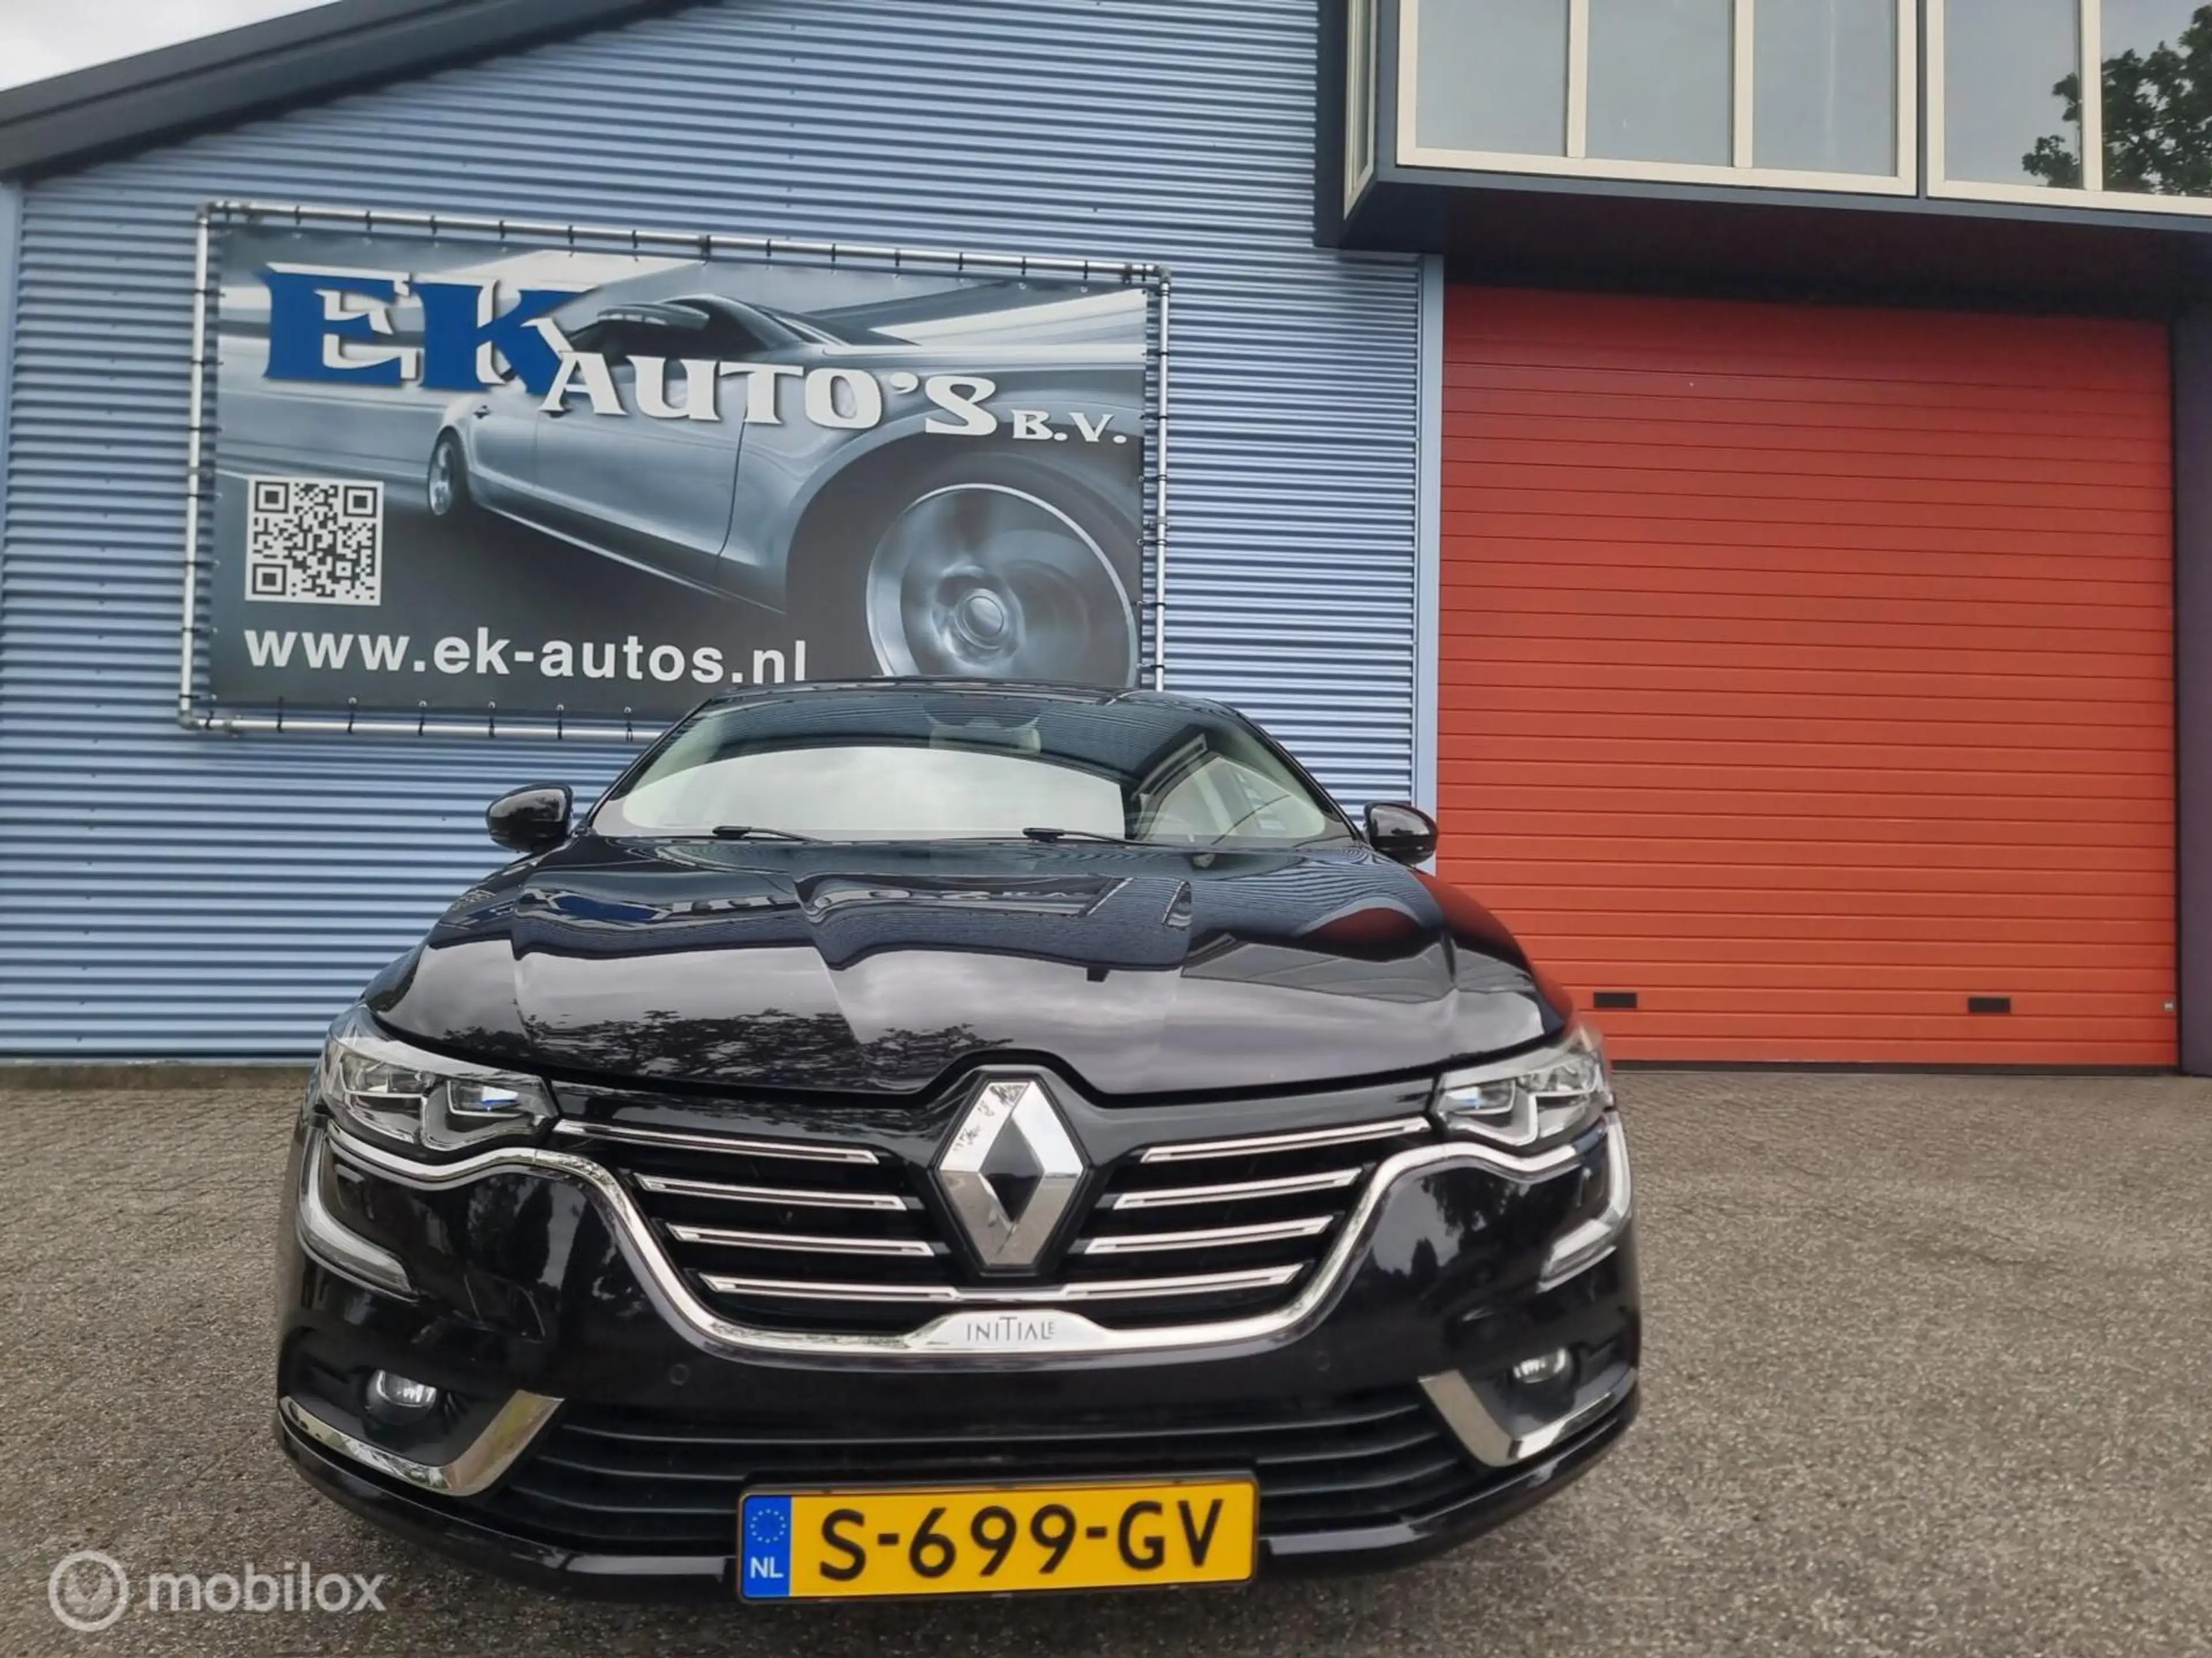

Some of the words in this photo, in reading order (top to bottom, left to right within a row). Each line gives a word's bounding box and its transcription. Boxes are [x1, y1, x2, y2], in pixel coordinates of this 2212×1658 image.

[263, 262, 602, 399] EK
[1012, 409, 1128, 445] B.V.
[244, 626, 807, 684] www.ek-autos.nl
[967, 1316, 1058, 1342] INITIALE
[749, 1557, 784, 1579] NL
[819, 1498, 1224, 1581] S-699-GV
